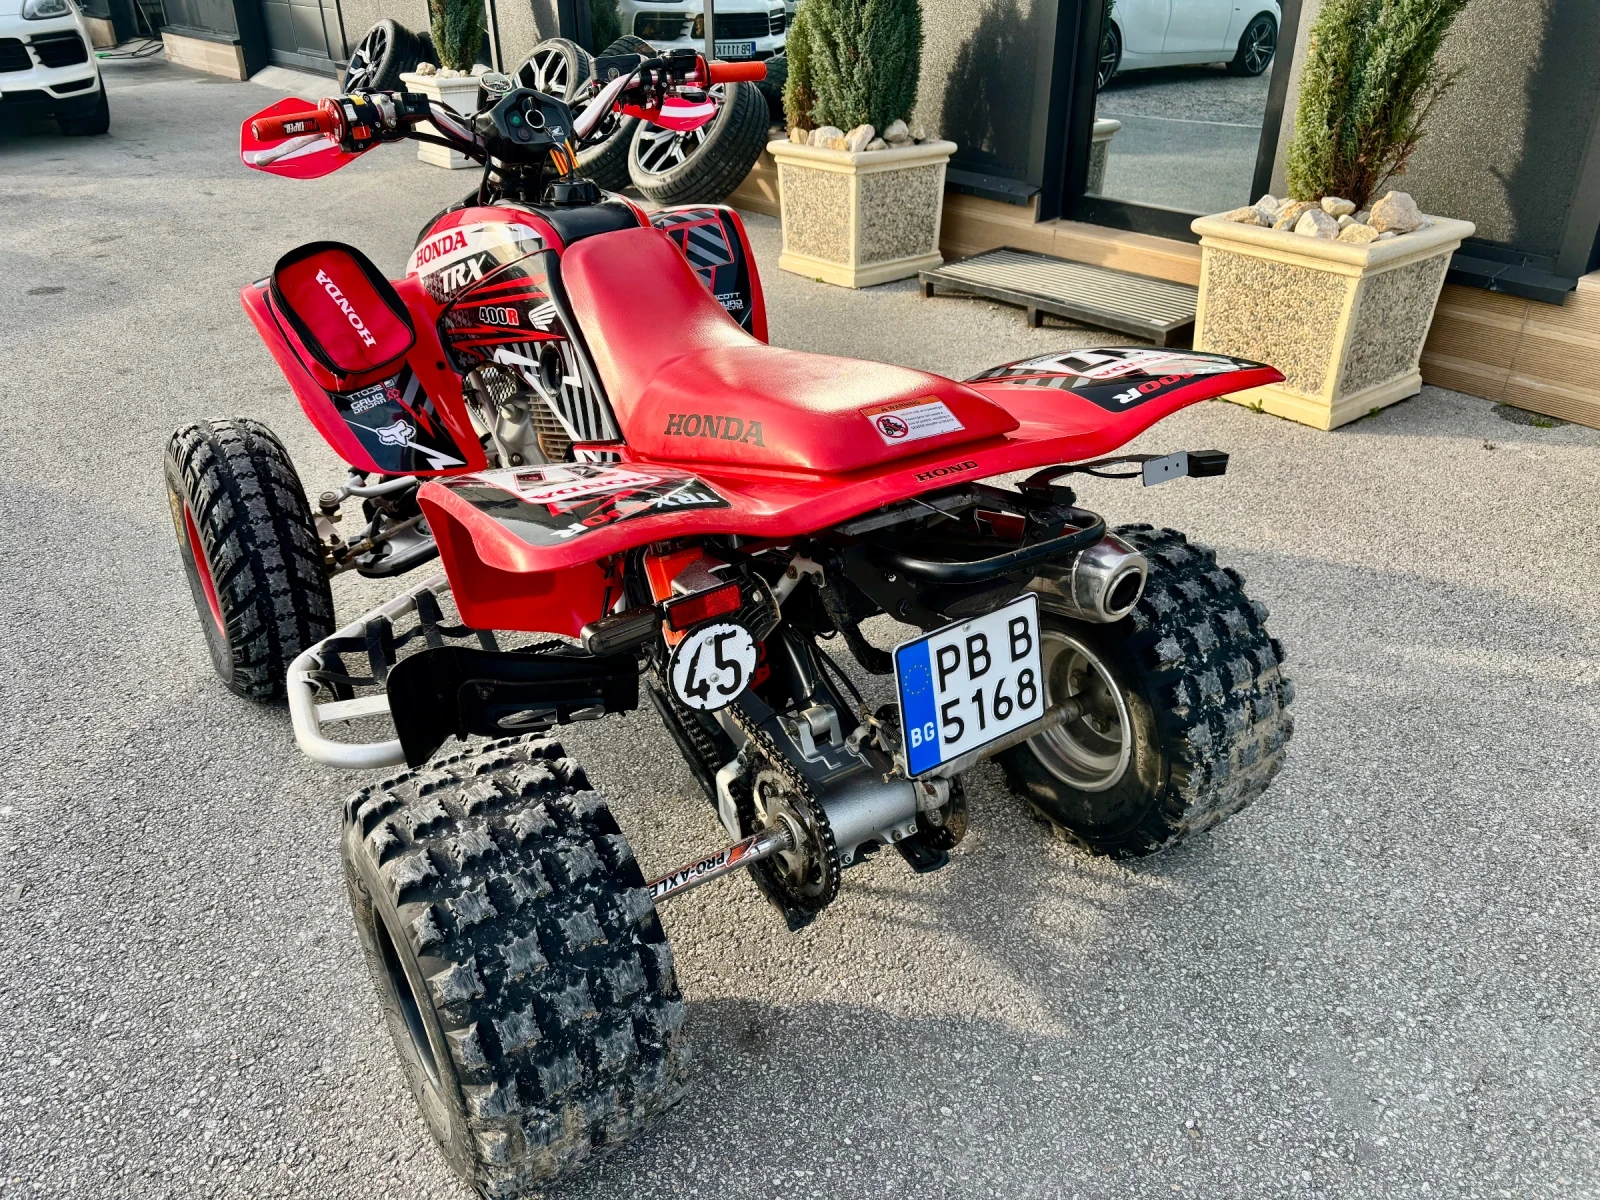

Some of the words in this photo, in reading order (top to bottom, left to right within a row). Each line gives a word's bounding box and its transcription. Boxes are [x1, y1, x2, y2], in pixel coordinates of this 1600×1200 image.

[416, 230, 468, 268] HONDA
[439, 253, 487, 294] TRX
[315, 268, 377, 348] HONDA
[479, 306, 520, 326] 400R
[664, 413, 766, 448] HONDA
[912, 460, 979, 482] HOND
[683, 629, 742, 702] 45
[935, 632, 992, 694] PB
[1008, 615, 1032, 663] B
[940, 668, 1037, 744] 5168
[911, 721, 935, 748] BG
[649, 851, 725, 899] PRO-AXLE
